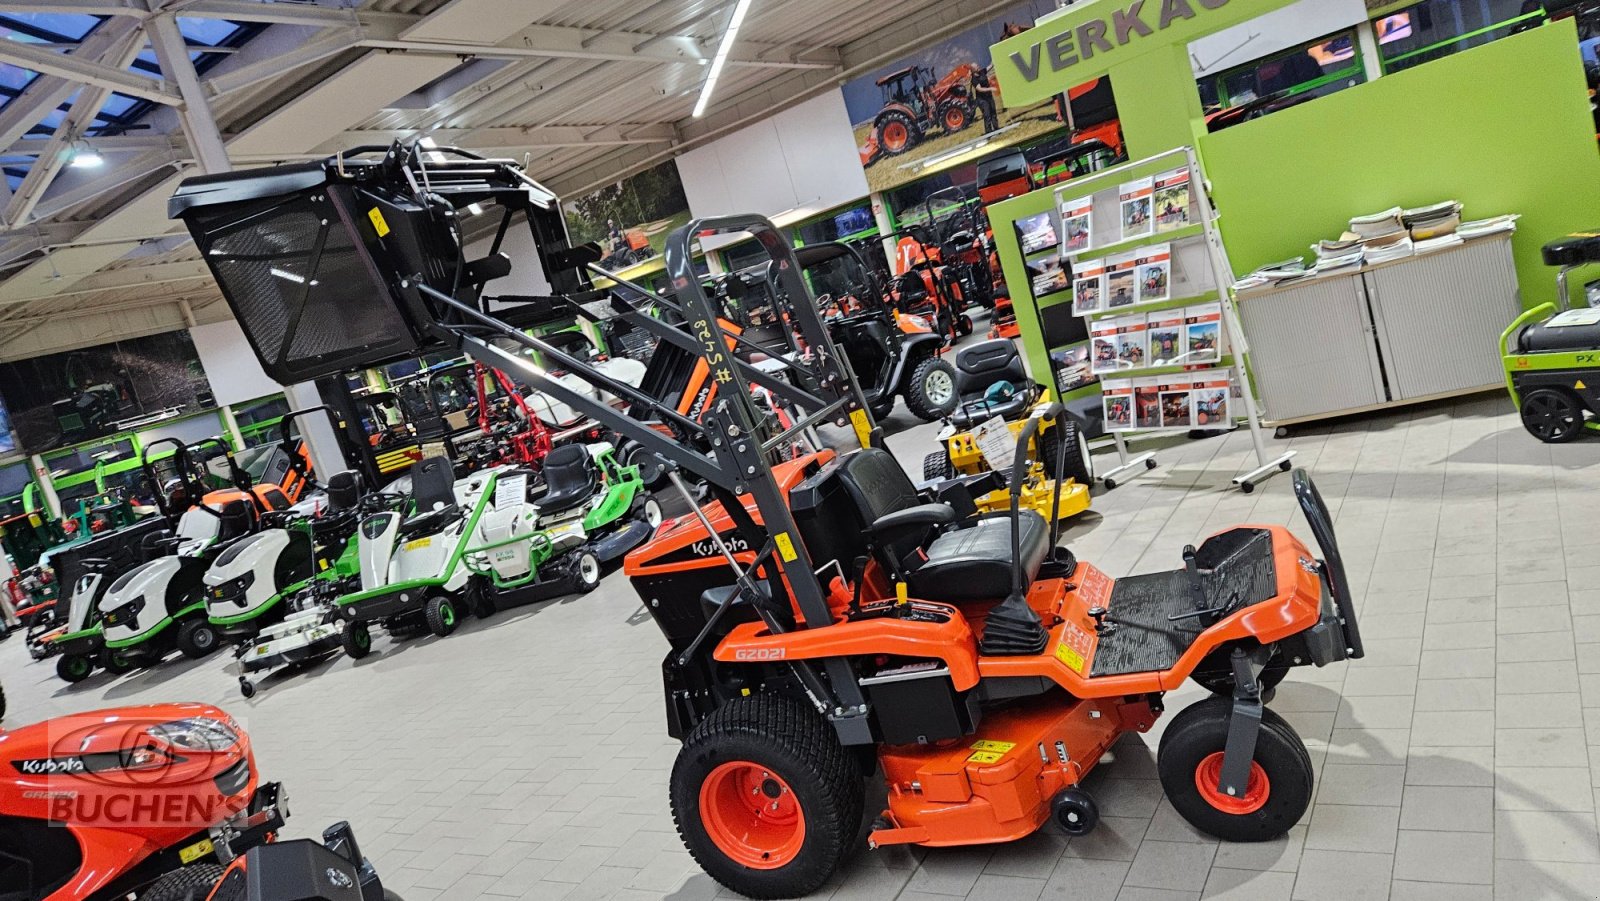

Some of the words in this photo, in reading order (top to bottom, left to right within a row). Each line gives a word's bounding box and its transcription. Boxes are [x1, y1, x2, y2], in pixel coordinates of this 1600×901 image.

[1009, 0, 1232, 83] VERKA
[692, 537, 749, 556] Kubota
[735, 647, 786, 661] GZD21
[22, 757, 84, 774] Kubota
